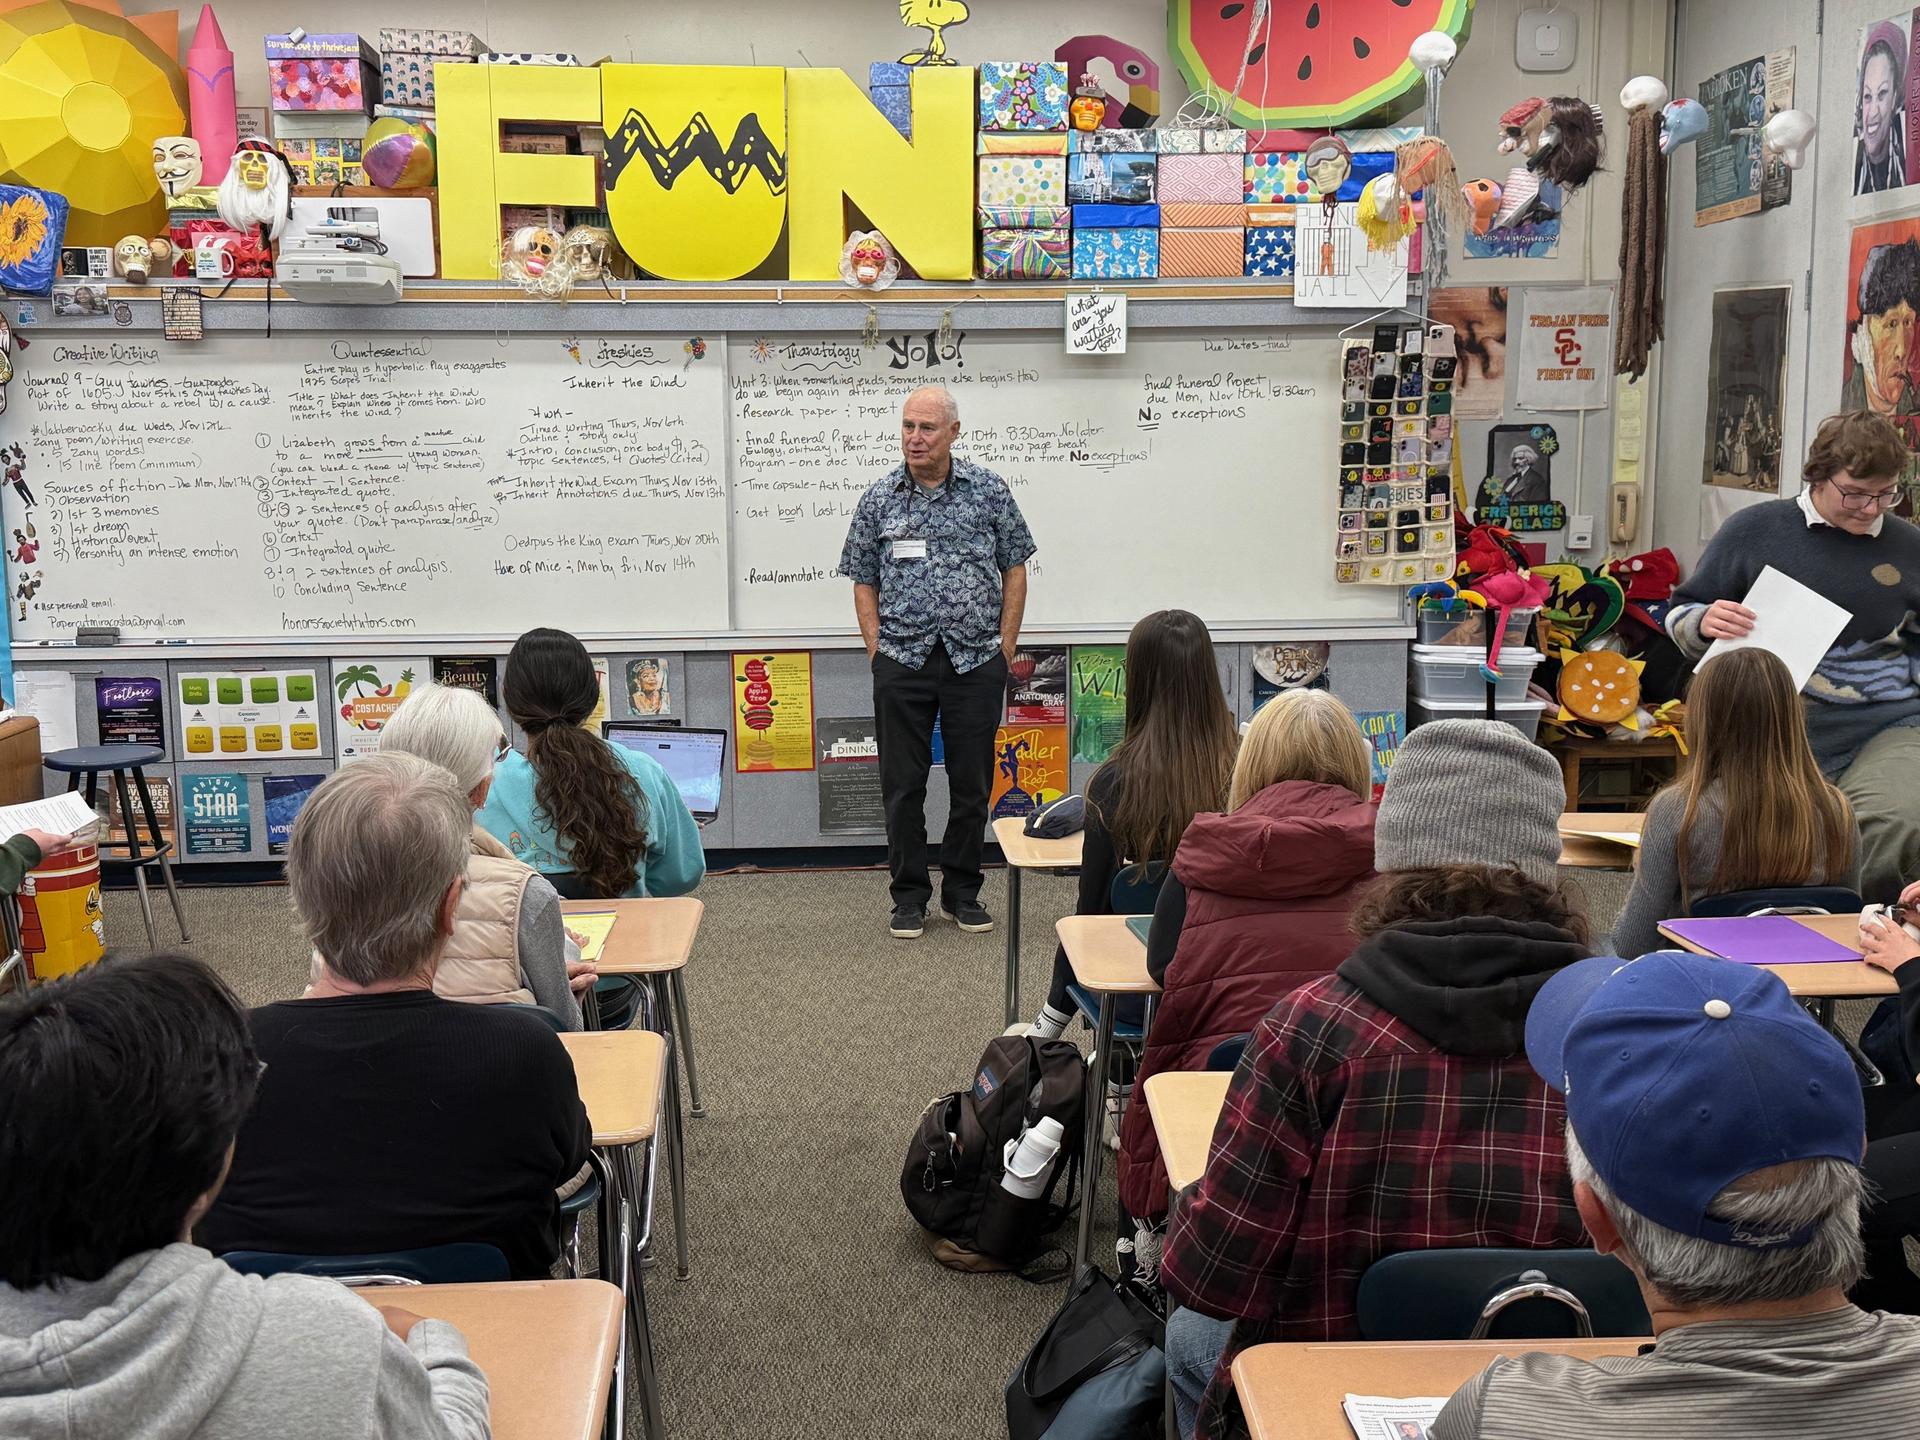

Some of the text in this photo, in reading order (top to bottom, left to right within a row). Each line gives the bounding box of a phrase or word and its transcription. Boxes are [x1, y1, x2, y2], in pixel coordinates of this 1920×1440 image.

[434, 62, 974, 281] FUN
[1299, 276, 1358, 297] JAIL
[1072, 299, 1116, 331] are you
[1530, 314, 1609, 327] TROJAN PRIDE
[1074, 324, 1115, 351] waiting
[53, 343, 160, 362] Creative Writing
[331, 337, 432, 359] Quintessential
[1554, 328, 1581, 366] SC
[304, 358, 450, 379] Entire play hyperbolic. Play
[1537, 368, 1595, 381] FIGHT ON!
[23, 371, 68, 388] Journal
[300, 375, 361, 388] 1925 Scopes
[563, 374, 688, 388] Inherit the Wind
[731, 373, 946, 390] Unit When something something
[27, 388, 71, 400] Plot of
[330, 390, 423, 401] What Inherit
[776, 387, 839, 401] begin again
[1147, 393, 1169, 404] due
[1272, 386, 1316, 397] 8:30am
[38, 396, 201, 414] Write story about rebel
[332, 400, 366, 409] Explain
[743, 401, 897, 421] Research paper project
[292, 408, 359, 421] inherits the
[1172, 406, 1246, 422] exceptions
[118, 422, 137, 432] due
[565, 422, 604, 436] writing
[66, 435, 144, 451] poem/writing
[344, 438, 376, 451] grows
[381, 434, 408, 448] from
[519, 433, 559, 443] Outline
[323, 448, 439, 463] more young
[517, 454, 666, 471] topic Quotes
[79, 459, 101, 470] line
[740, 455, 888, 472] Program Video
[44, 477, 166, 494] Sources of fiction
[271, 477, 317, 488] Context
[603, 478, 638, 487] Exam
[741, 479, 809, 494] Time capsule
[58, 493, 130, 505] Observation
[275, 486, 353, 501] Integrated
[556, 489, 618, 500] Annotations
[104, 503, 160, 517] memories
[312, 499, 445, 518] sentences analysis
[747, 506, 769, 518] Get
[1481, 504, 1563, 518] FREDERICK
[93, 521, 130, 533] dream
[273, 520, 300, 533] your
[280, 532, 324, 544] Context
[504, 534, 639, 551] Oedipus exam
[75, 541, 240, 566] Personify emotion
[285, 540, 353, 561] Integrated
[320, 565, 376, 577] sentences
[535, 559, 561, 573] Mice
[750, 567, 824, 584] Read/annotate
[294, 579, 354, 604] Concluding
[282, 611, 416, 630] honorssocietytutors.com
[1080, 655, 1112, 665] The
[1273, 647, 1309, 661] PETER
[1275, 659, 1307, 675] PAN
[441, 670, 488, 684] Beauty
[104, 686, 154, 705] Footloose
[1014, 693, 1051, 701] ANATOMY
[838, 745, 876, 754] DINING
[1018, 767, 1064, 788] Roof
[193, 779, 237, 793] BRIGHT
[194, 793, 238, 817] STAR
